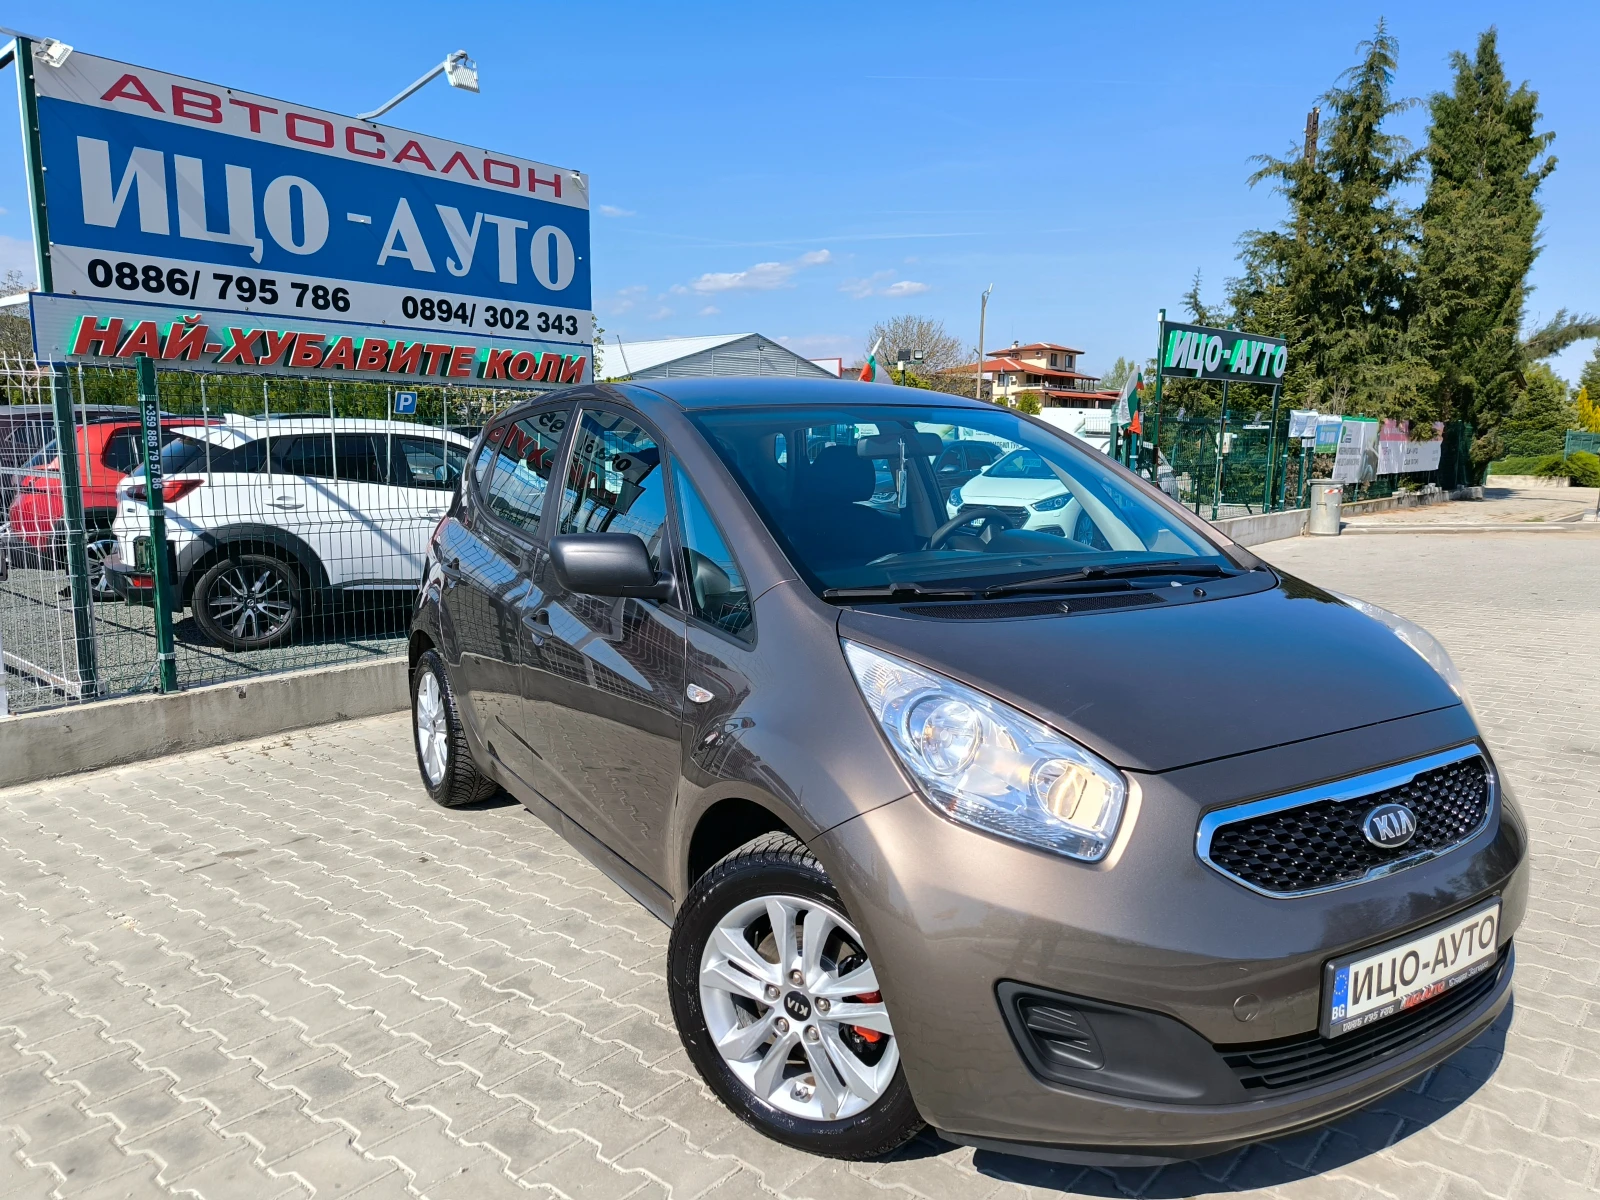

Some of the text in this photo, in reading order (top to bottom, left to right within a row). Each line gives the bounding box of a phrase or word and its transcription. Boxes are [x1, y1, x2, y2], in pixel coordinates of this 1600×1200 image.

[101, 74, 562, 198] АВТОСАЛОН
[88, 259, 350, 312] 0886/ 795 786
[402, 295, 578, 335] 0894/ 302 343
[72, 314, 586, 384] НАЙ-ХУБАВИТЕ КОЛИ
[1166, 330, 1288, 379] ИЦО-АУТО
[146, 404, 163, 489] +359 886 79 57 86
[1372, 809, 1414, 841] KIA
[1351, 915, 1496, 1006] ИЦО-АУТО
[787, 996, 808, 1017] KIA
[1331, 1004, 1345, 1021] BG
